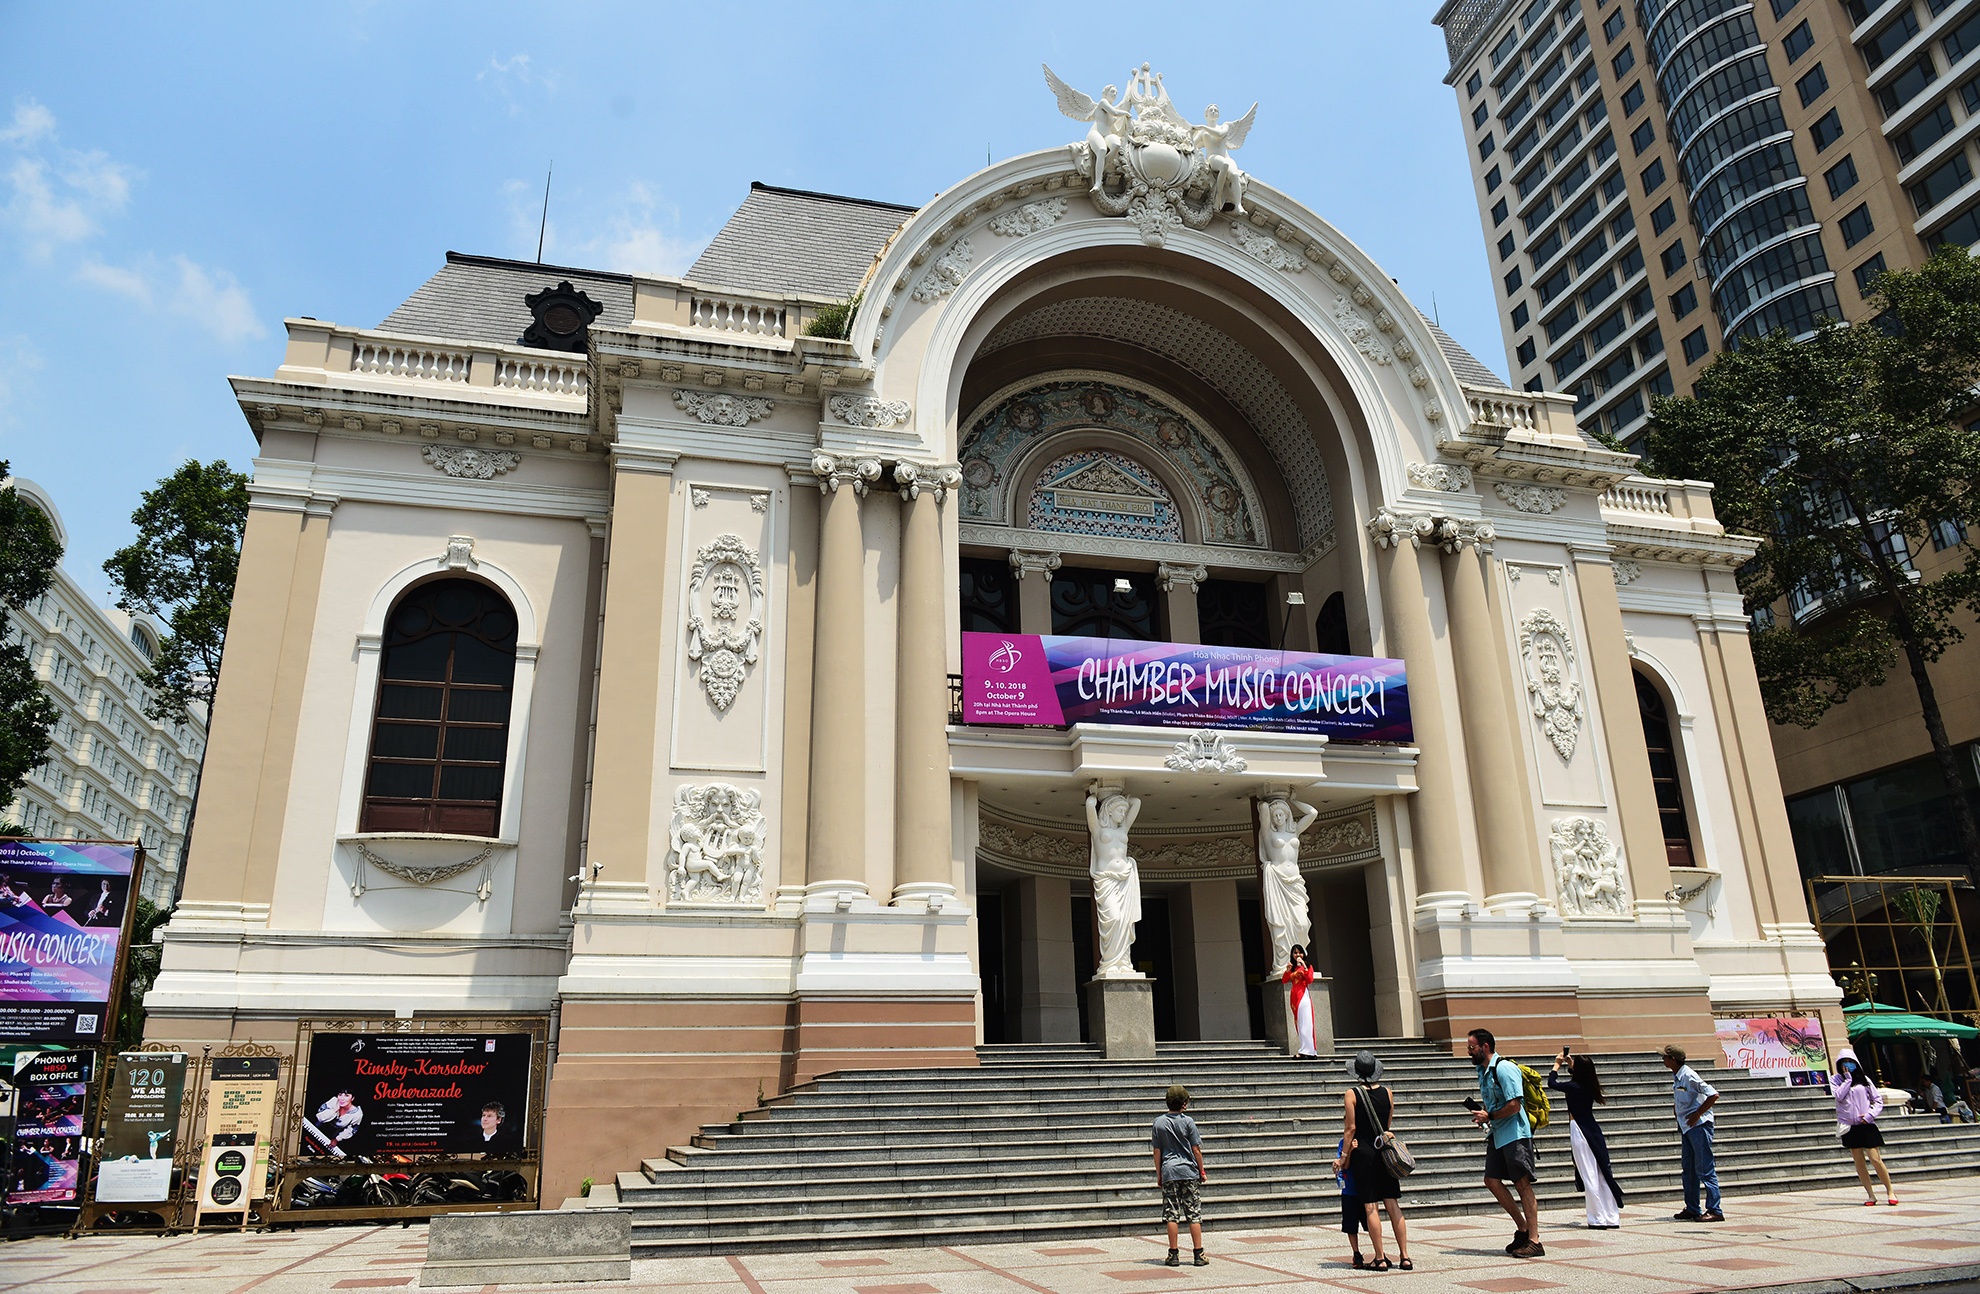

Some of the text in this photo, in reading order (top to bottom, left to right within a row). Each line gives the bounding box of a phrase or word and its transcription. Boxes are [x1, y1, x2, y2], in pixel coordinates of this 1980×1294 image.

[1077, 657, 1386, 717] CHAMBER MUSIC CONCERT
[987, 692, 1024, 700] October 9
[0, 932, 110, 966] USIC CONCERT
[35, 1056, 65, 1064] PHÒNG
[1738, 1048, 1807, 1069] Fledermaus
[43, 1064, 67, 1072] HBSO
[49, 1072, 78, 1080] OFFICE
[129, 1069, 165, 1086] 120
[373, 1082, 463, 1100] Sheherazade
